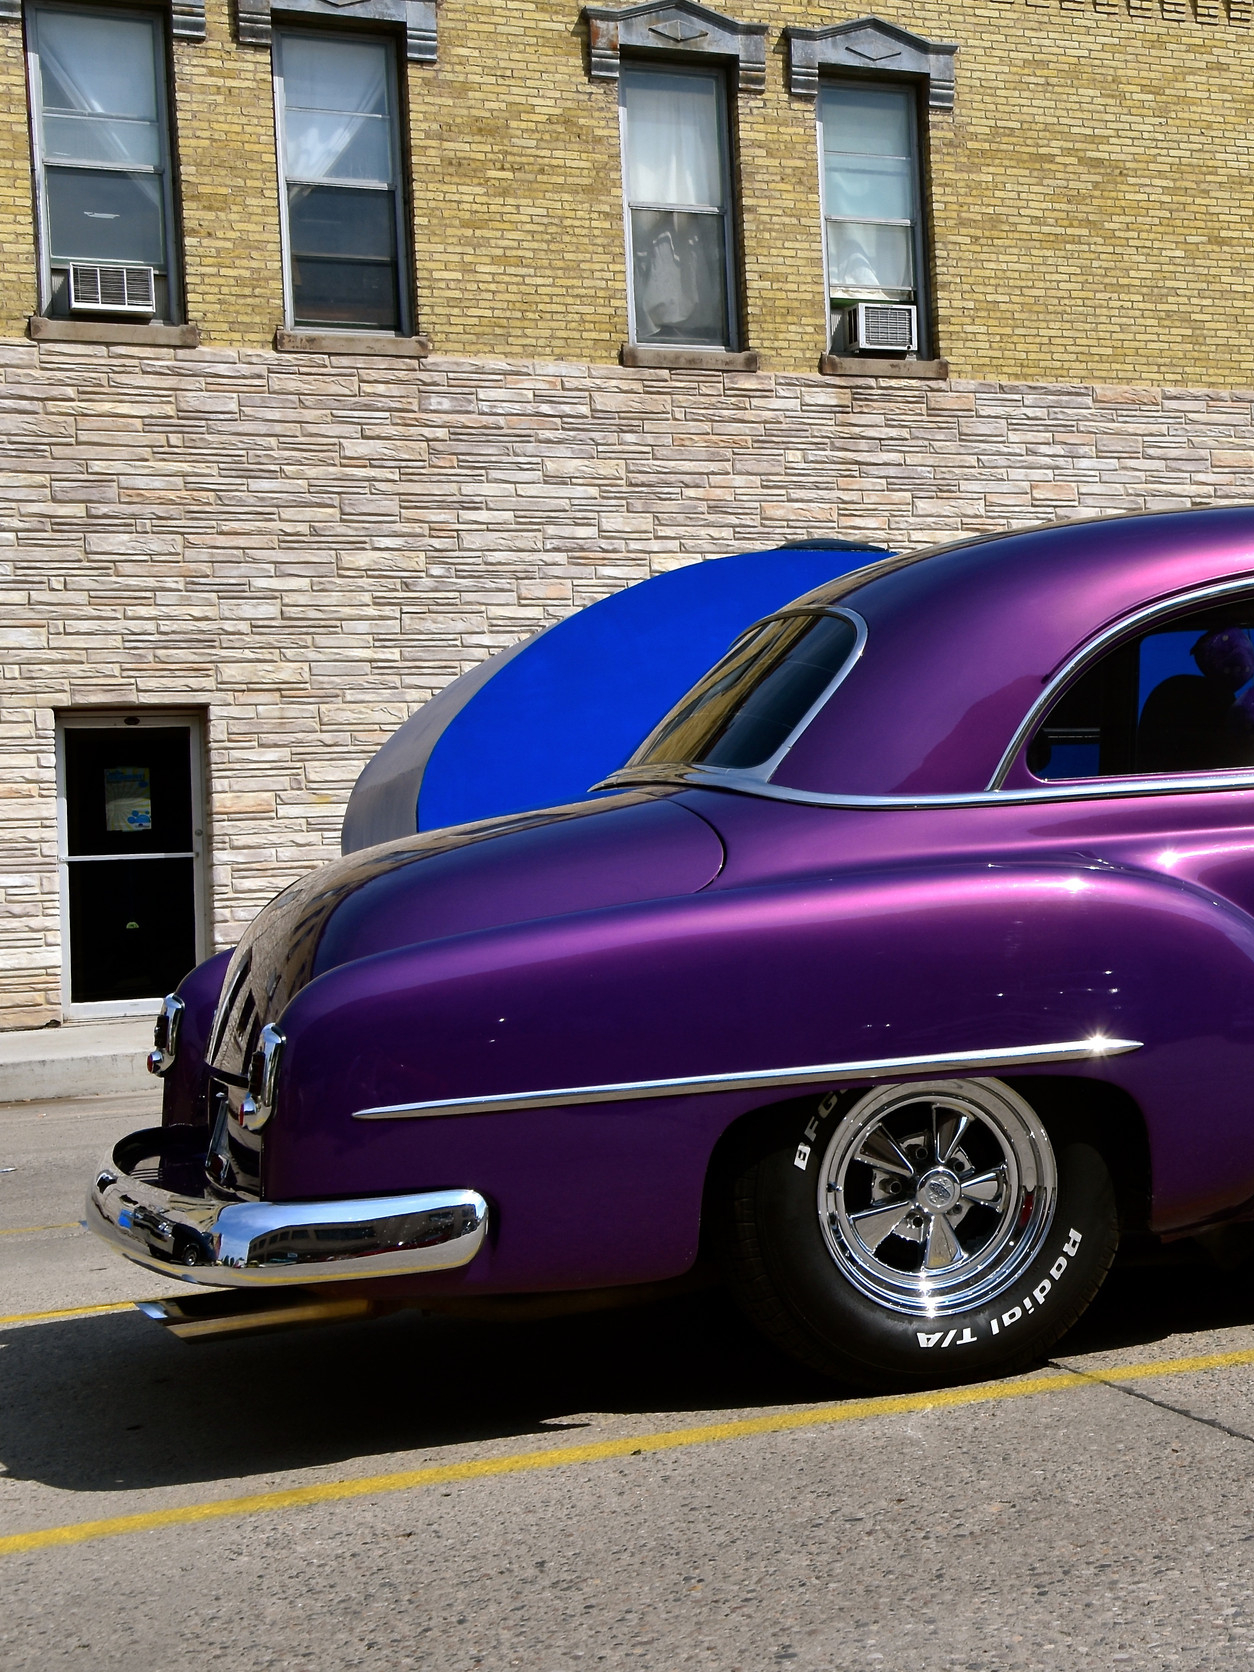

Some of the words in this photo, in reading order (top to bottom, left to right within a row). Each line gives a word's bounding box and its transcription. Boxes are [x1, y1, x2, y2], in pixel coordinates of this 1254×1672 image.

[793, 1089, 849, 1171] BFG
[990, 1228, 1082, 1335] Radial
[917, 1327, 977, 1348] T/A
